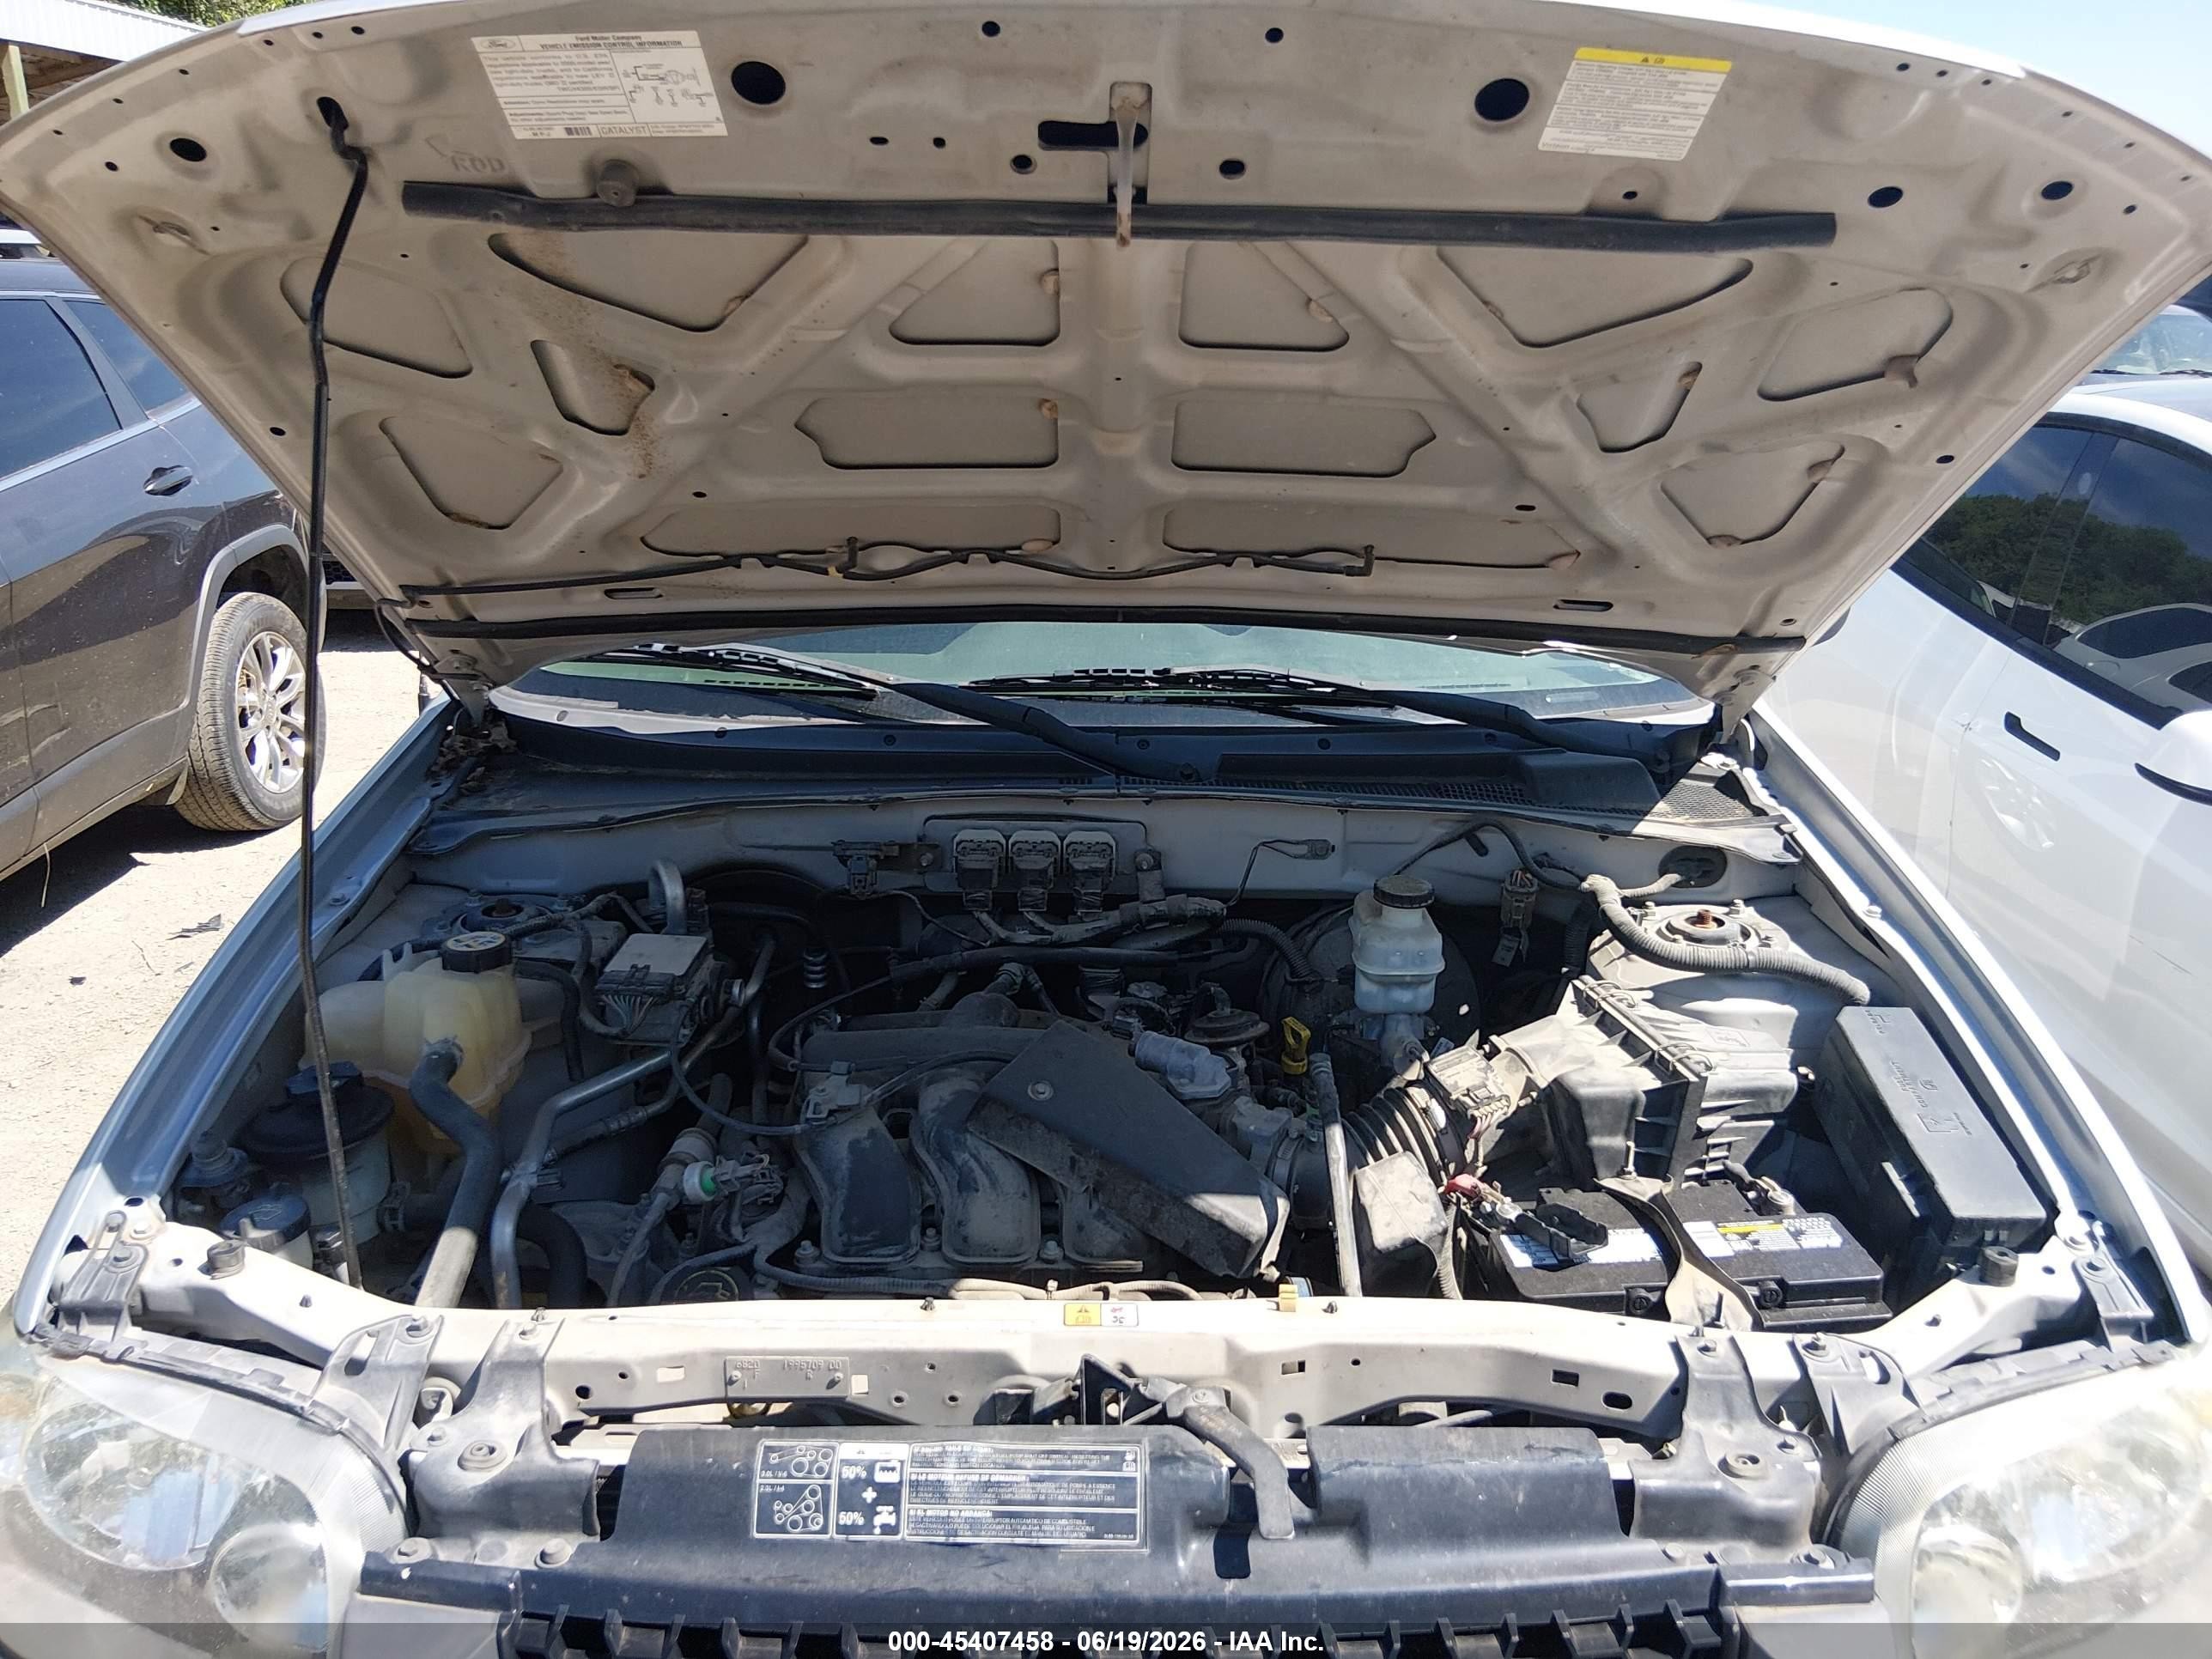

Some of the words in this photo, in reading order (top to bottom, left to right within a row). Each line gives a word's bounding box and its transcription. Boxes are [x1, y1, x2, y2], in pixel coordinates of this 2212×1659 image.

[601, 126, 647, 135] CATALYST
[841, 1465, 867, 1480] 50%
[838, 1511, 865, 1526] 50%
